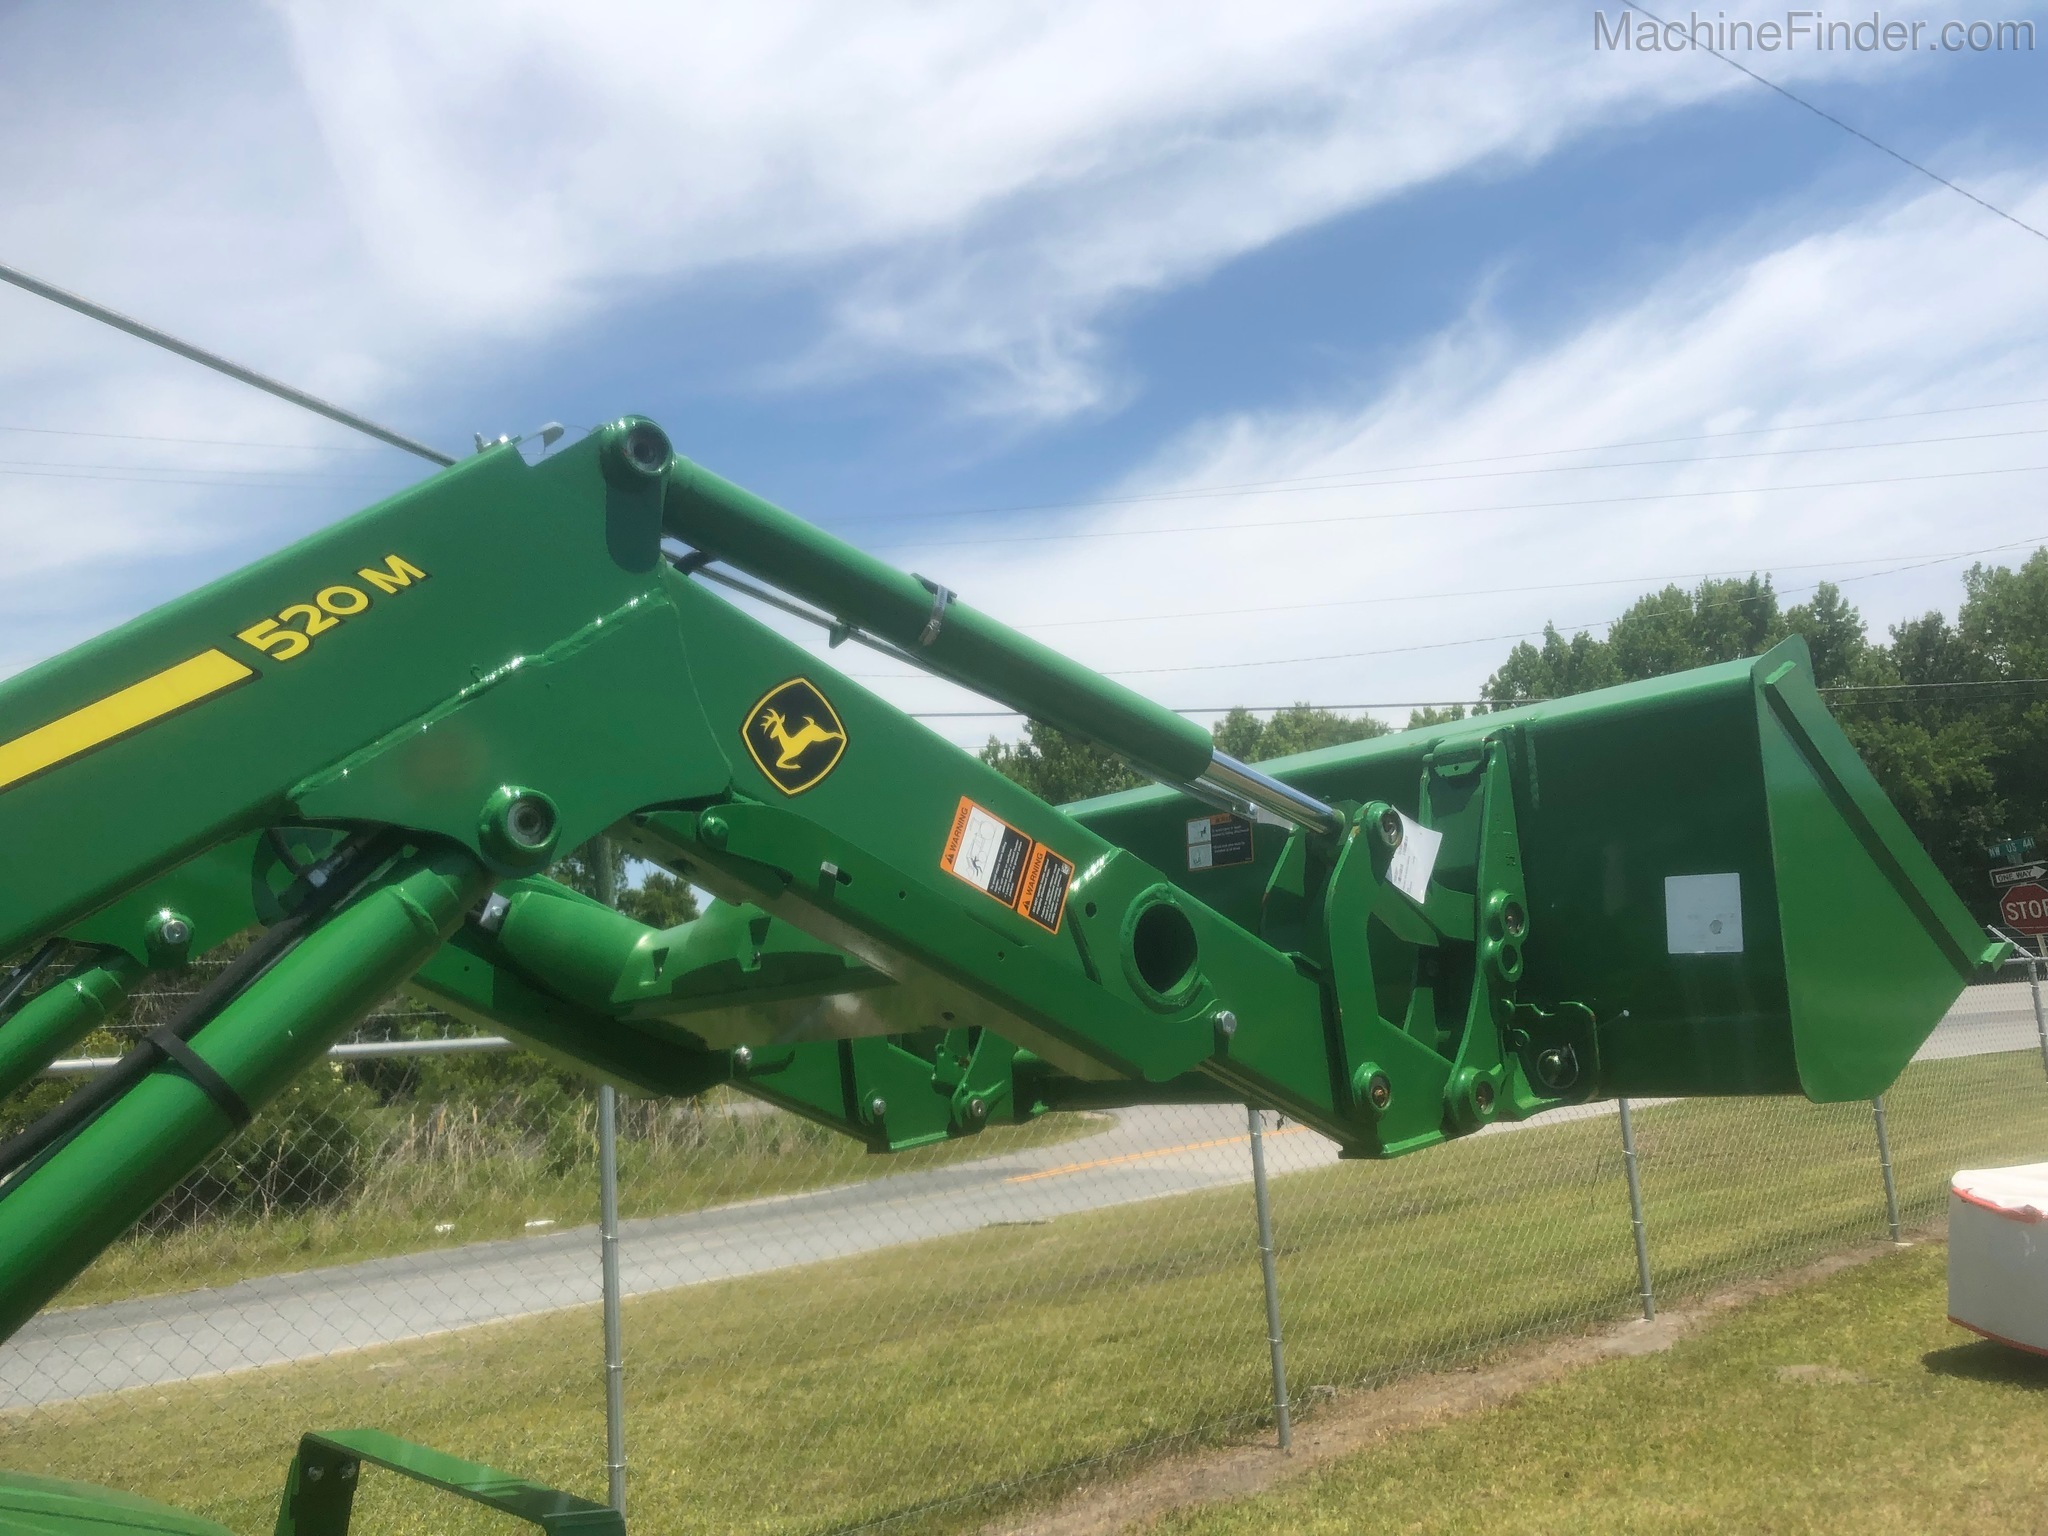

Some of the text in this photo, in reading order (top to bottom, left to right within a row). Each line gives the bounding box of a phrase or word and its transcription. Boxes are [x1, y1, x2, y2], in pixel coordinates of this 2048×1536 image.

[236, 554, 427, 661] 520 M
[949, 807, 968, 852] WARNING
[2006, 842, 2017, 853] US
[1026, 853, 1043, 896] WARNING
[1998, 870, 2032, 882] ONE WAY
